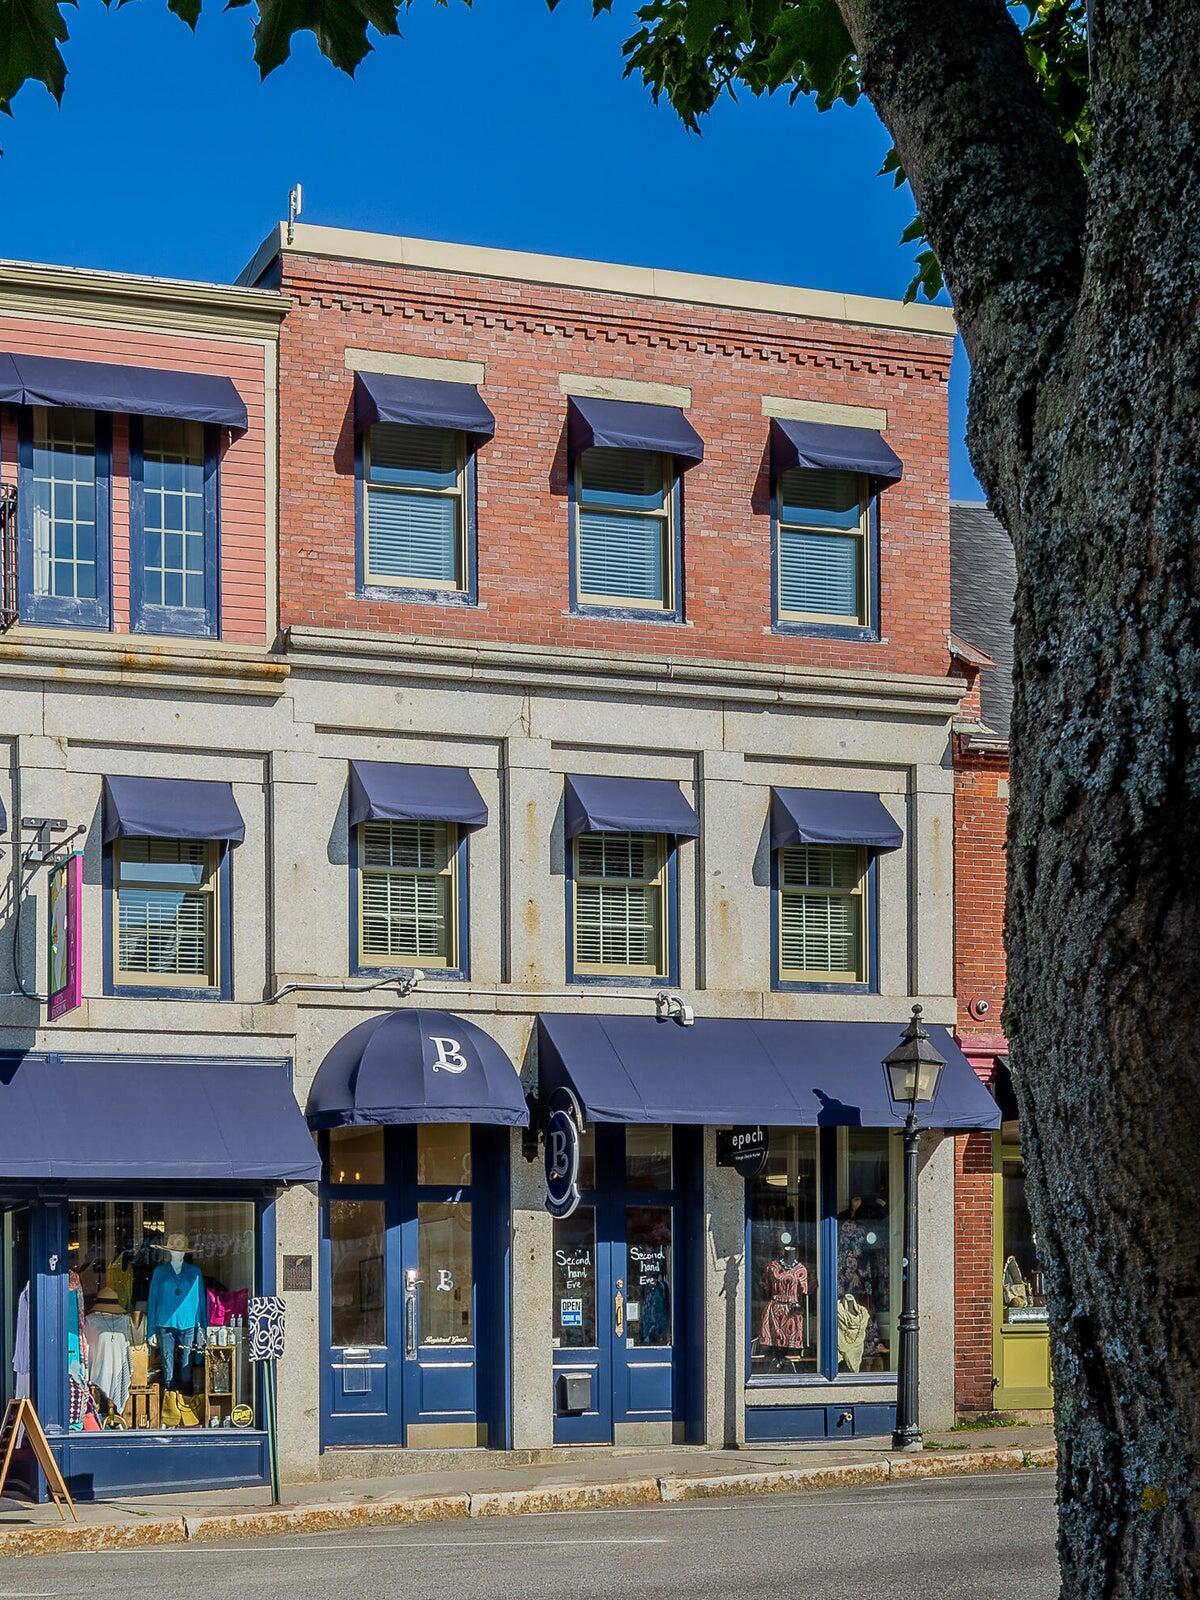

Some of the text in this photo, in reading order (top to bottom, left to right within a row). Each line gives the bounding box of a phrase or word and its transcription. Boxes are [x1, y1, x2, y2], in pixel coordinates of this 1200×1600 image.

[429, 1036, 467, 1074] B
[732, 1125, 763, 1150] epoch
[549, 1130, 569, 1181] B
[555, 1249, 591, 1266] Second
[630, 1245, 666, 1261] Second
[567, 1265, 587, 1278] hand
[640, 1260, 660, 1272] hand
[436, 1269, 454, 1291] B
[562, 1301, 581, 1311] OPEN
